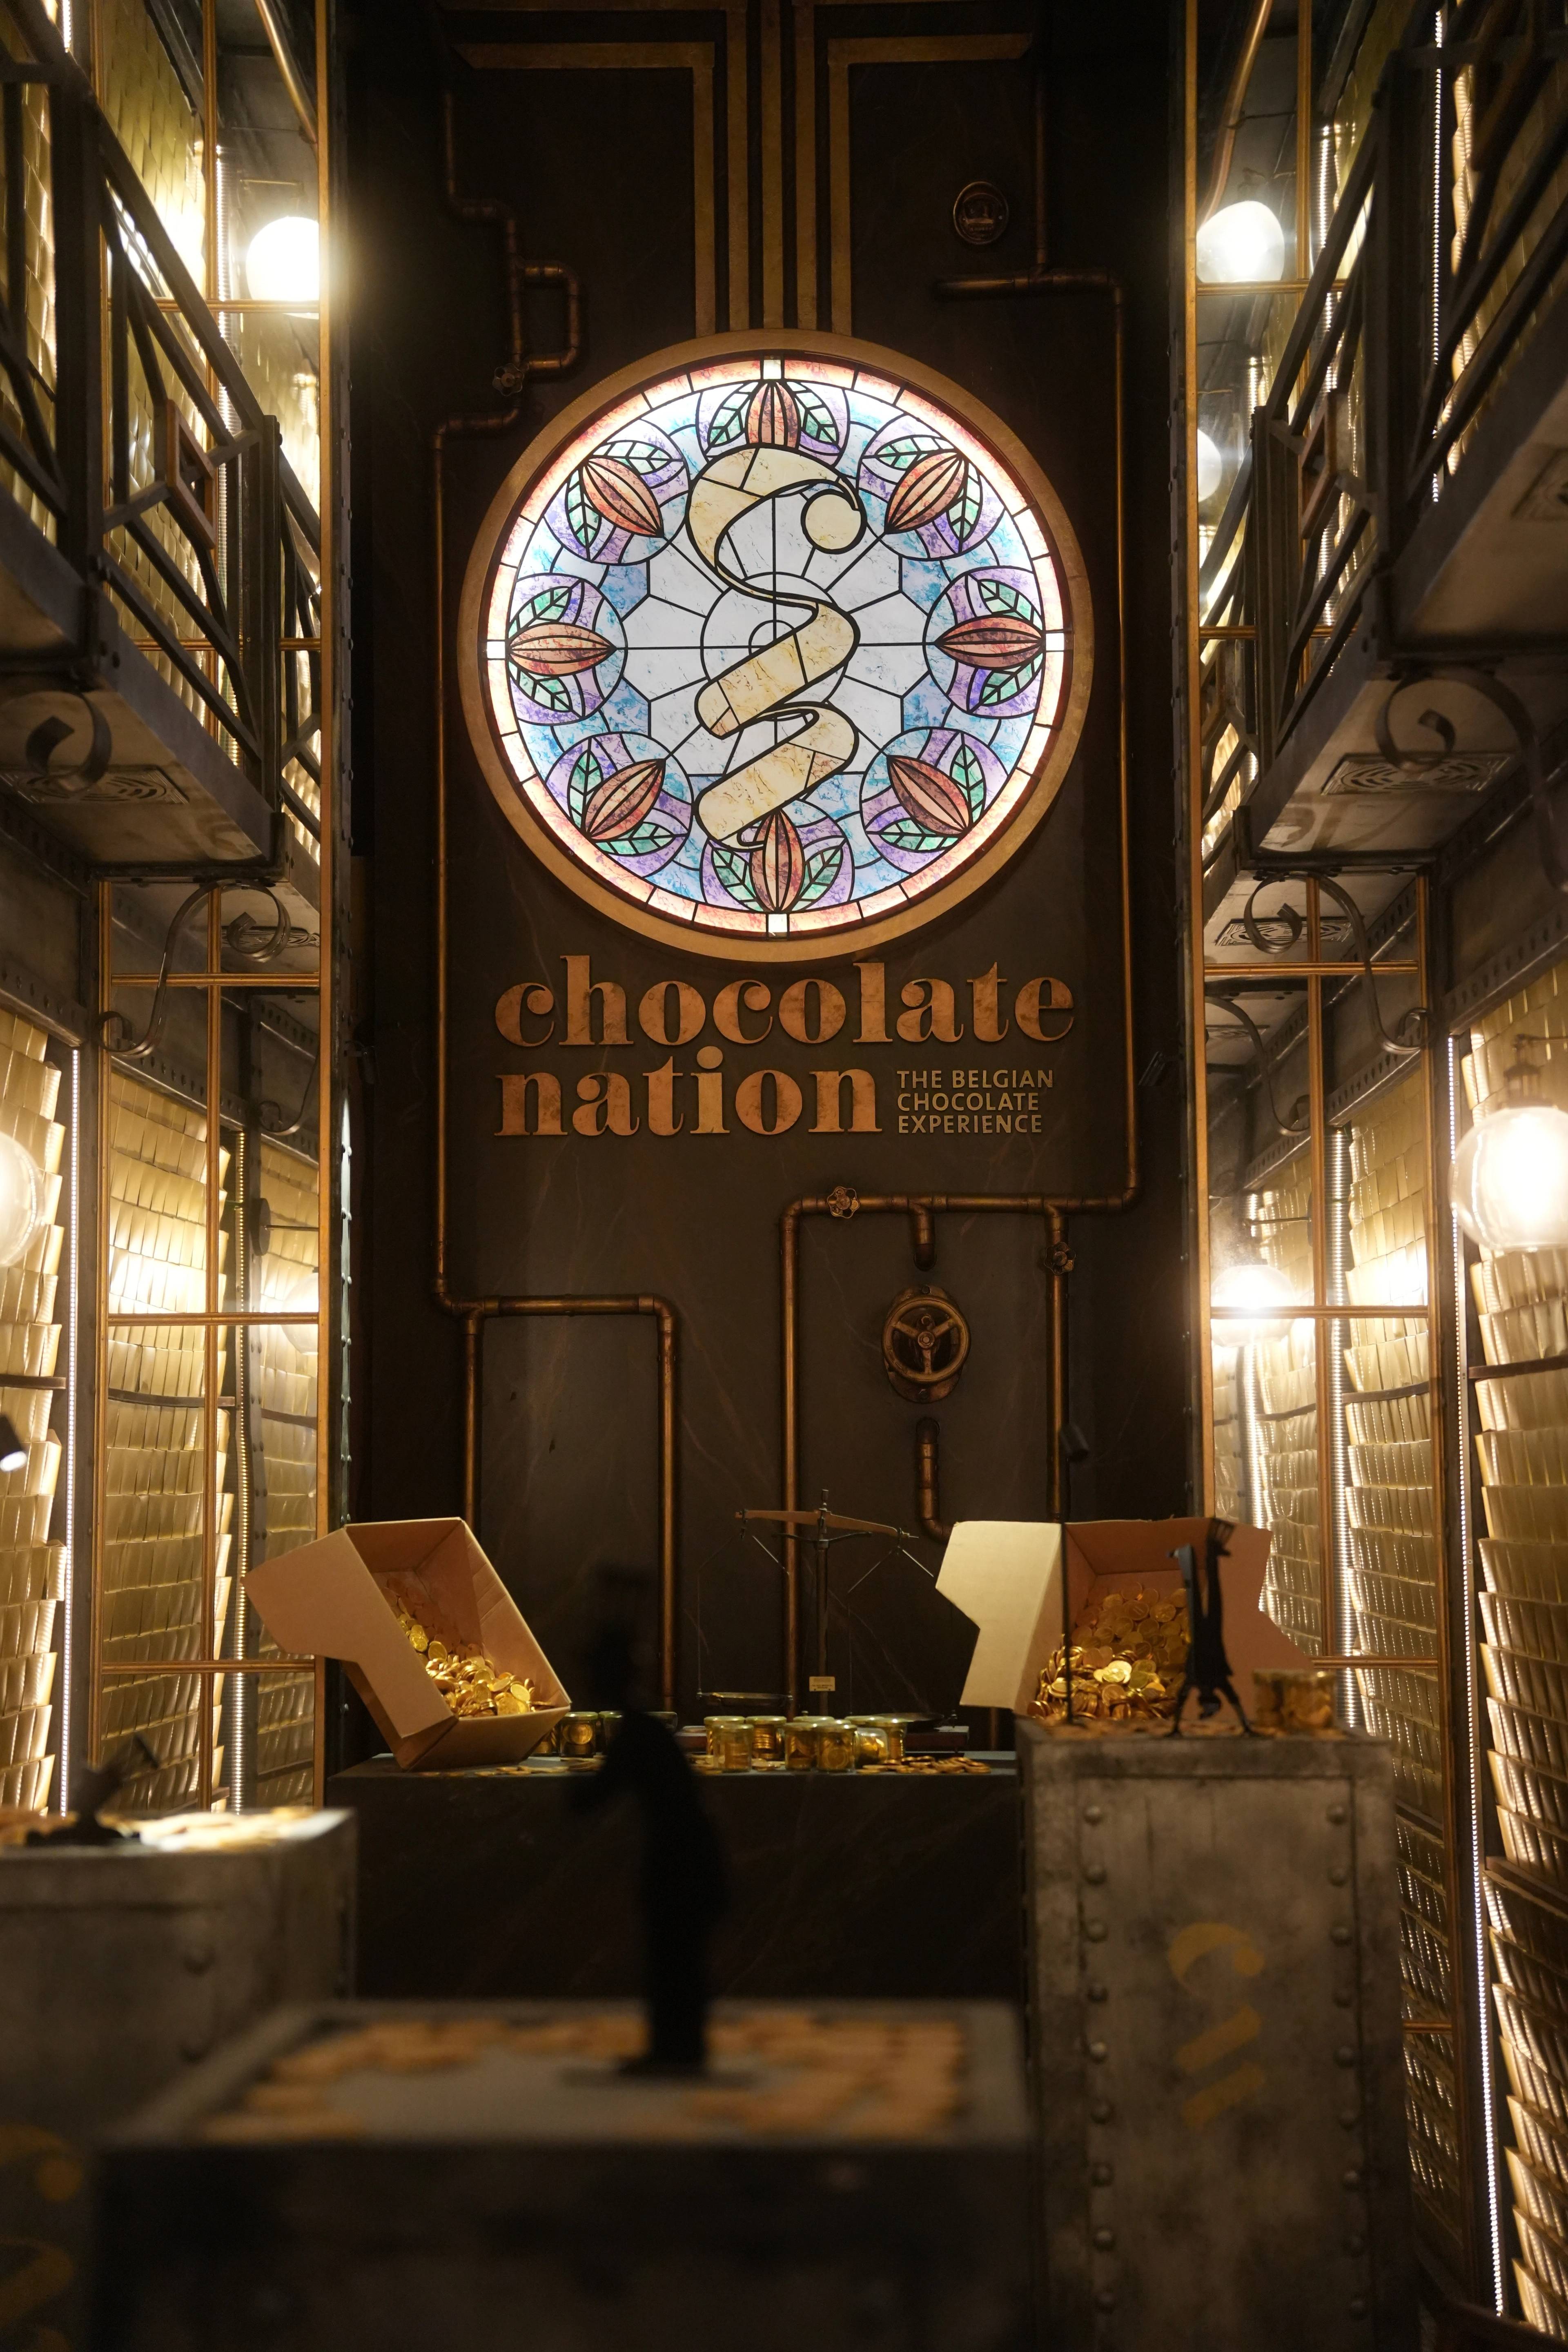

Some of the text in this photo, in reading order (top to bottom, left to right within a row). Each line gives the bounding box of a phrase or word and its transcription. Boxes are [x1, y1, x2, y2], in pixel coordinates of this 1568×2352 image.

[495, 955, 1075, 1047] chocolate
[897, 1069, 1054, 1089] THE BELGIAN
[494, 1045, 882, 1136] nation
[898, 1092, 1039, 1111] CHOCOLATE
[898, 1114, 1042, 1134] EXPERIENCE
